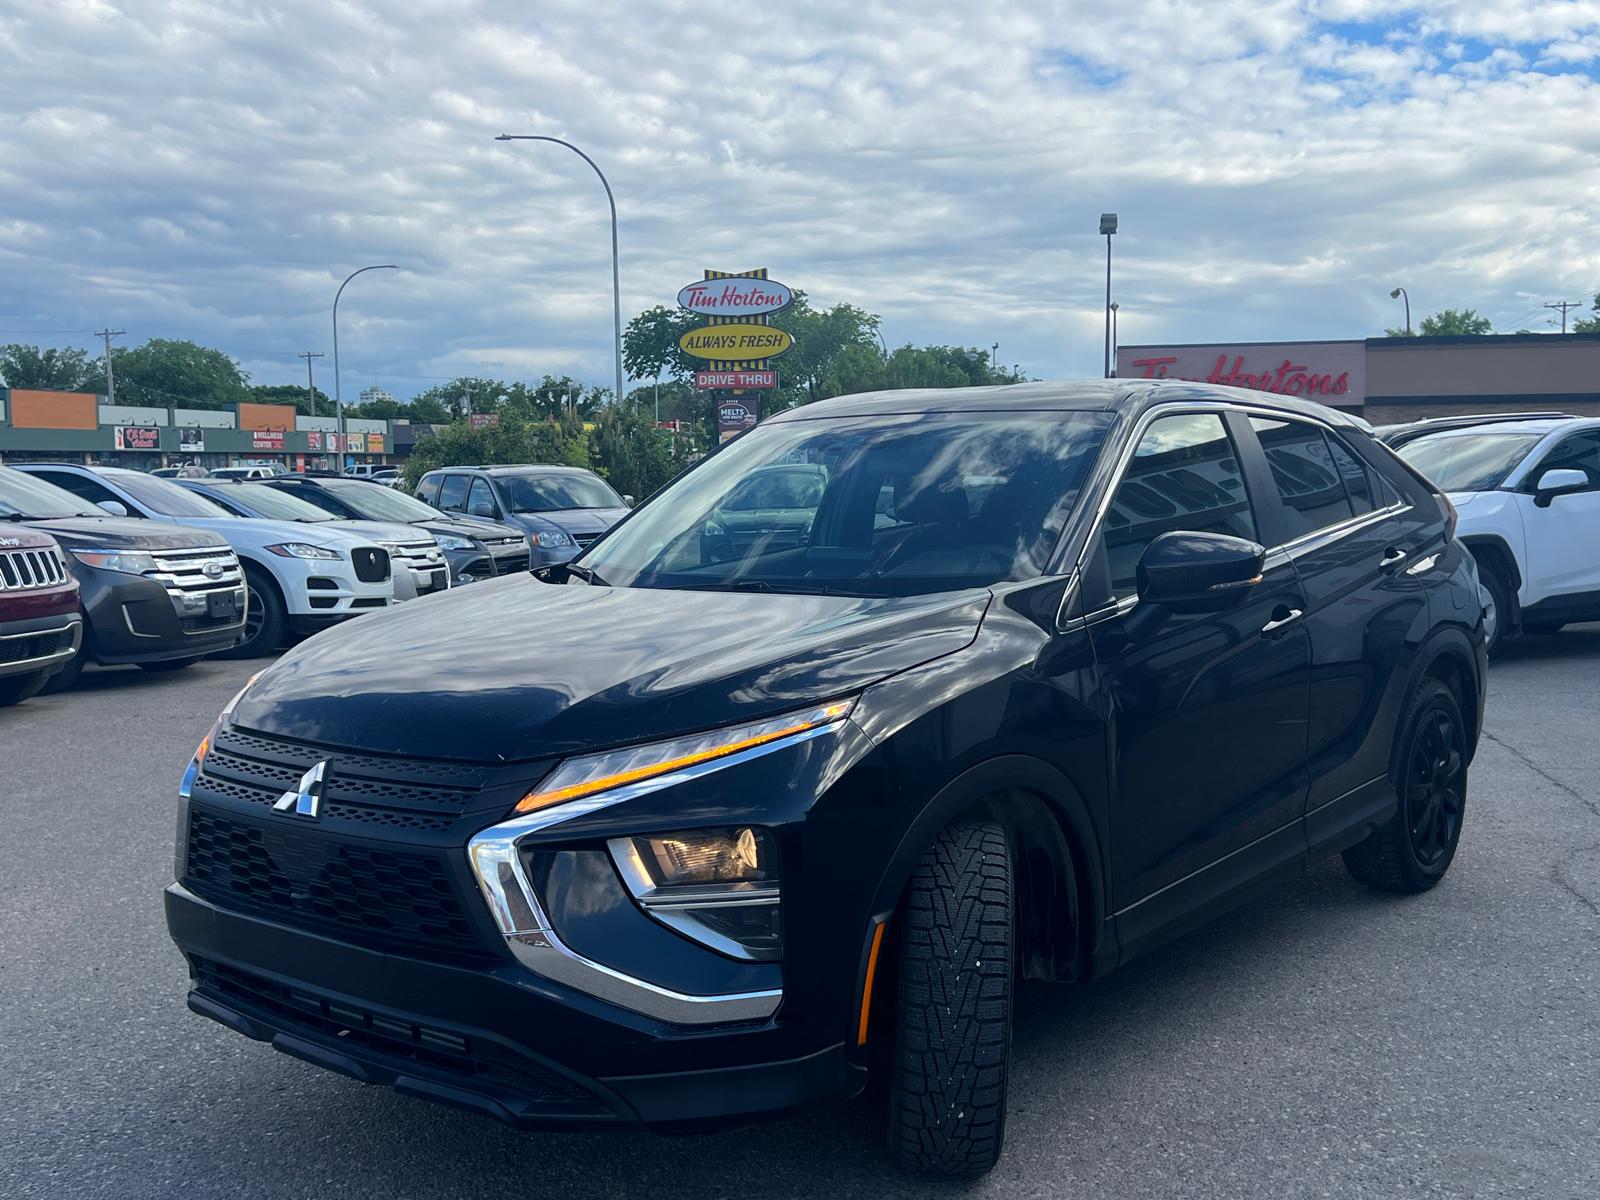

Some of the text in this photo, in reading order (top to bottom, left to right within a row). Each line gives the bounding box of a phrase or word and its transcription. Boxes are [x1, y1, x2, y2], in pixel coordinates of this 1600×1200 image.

[687, 285, 783, 308] Tim Hortons
[685, 334, 784, 349] ALWAYS FRESH
[699, 374, 772, 386] DRIVE THRU
[720, 408, 745, 416] MELTS
